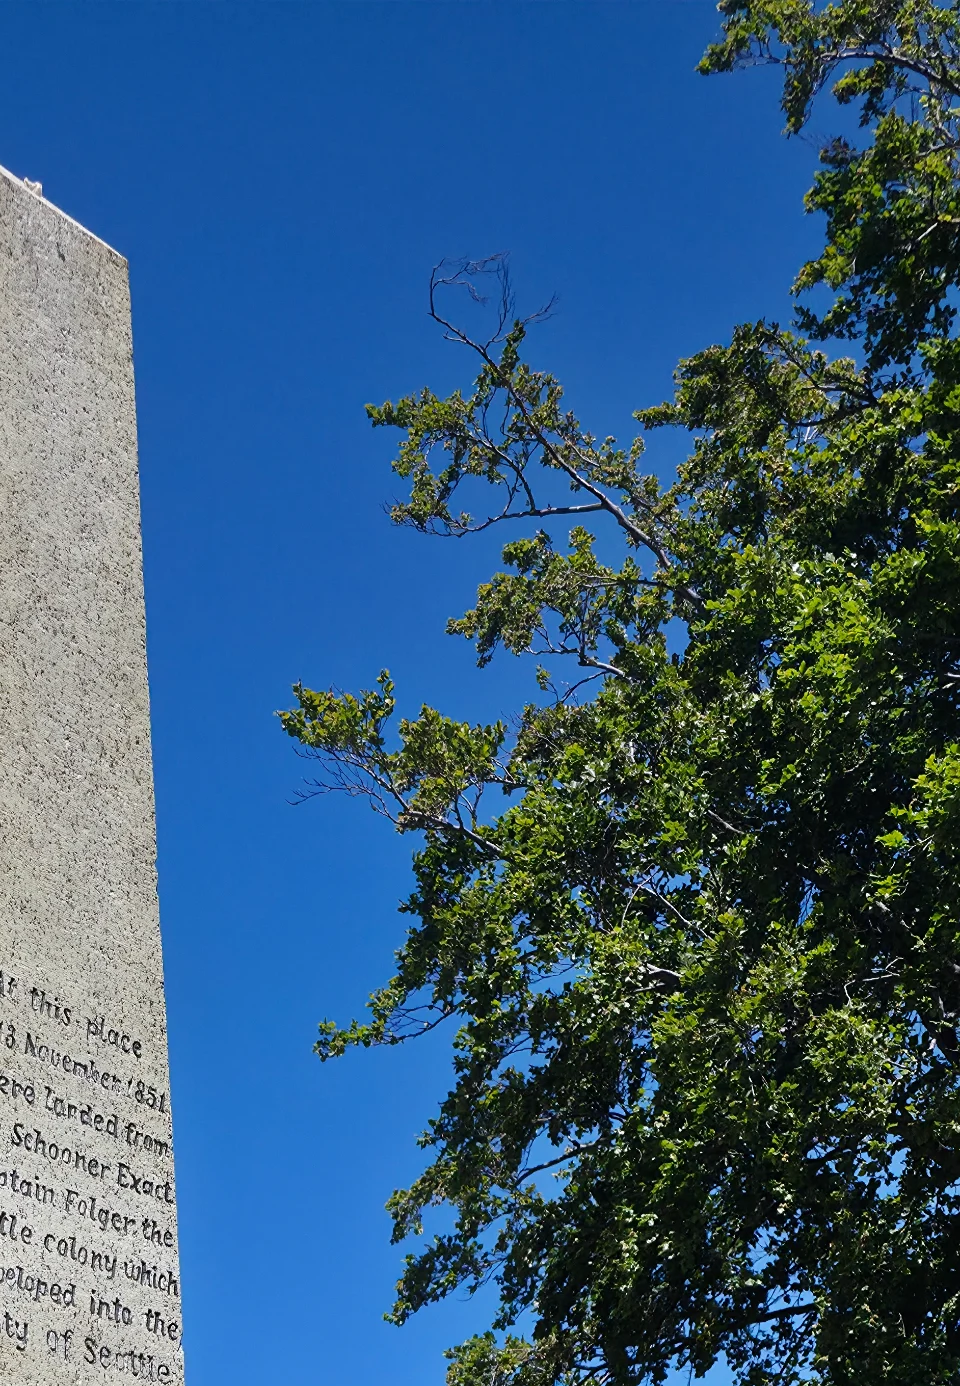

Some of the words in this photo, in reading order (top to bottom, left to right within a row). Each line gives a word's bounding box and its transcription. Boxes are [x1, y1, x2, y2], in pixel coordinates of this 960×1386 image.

[31, 986, 72, 1027] this
[87, 1016, 142, 1059] place
[25, 1033, 122, 1093] November
[11, 1124, 111, 1182] Schooner
[125, 1124, 172, 1159] from
[65, 1191, 135, 1237] Folger
[143, 1217, 173, 1248] the
[44, 1231, 119, 1278] colony
[124, 1260, 179, 1297] which
[90, 1290, 133, 1326] into
[144, 1311, 181, 1342] the
[45, 1329, 74, 1363] of
[84, 1338, 173, 1385] Seattle
